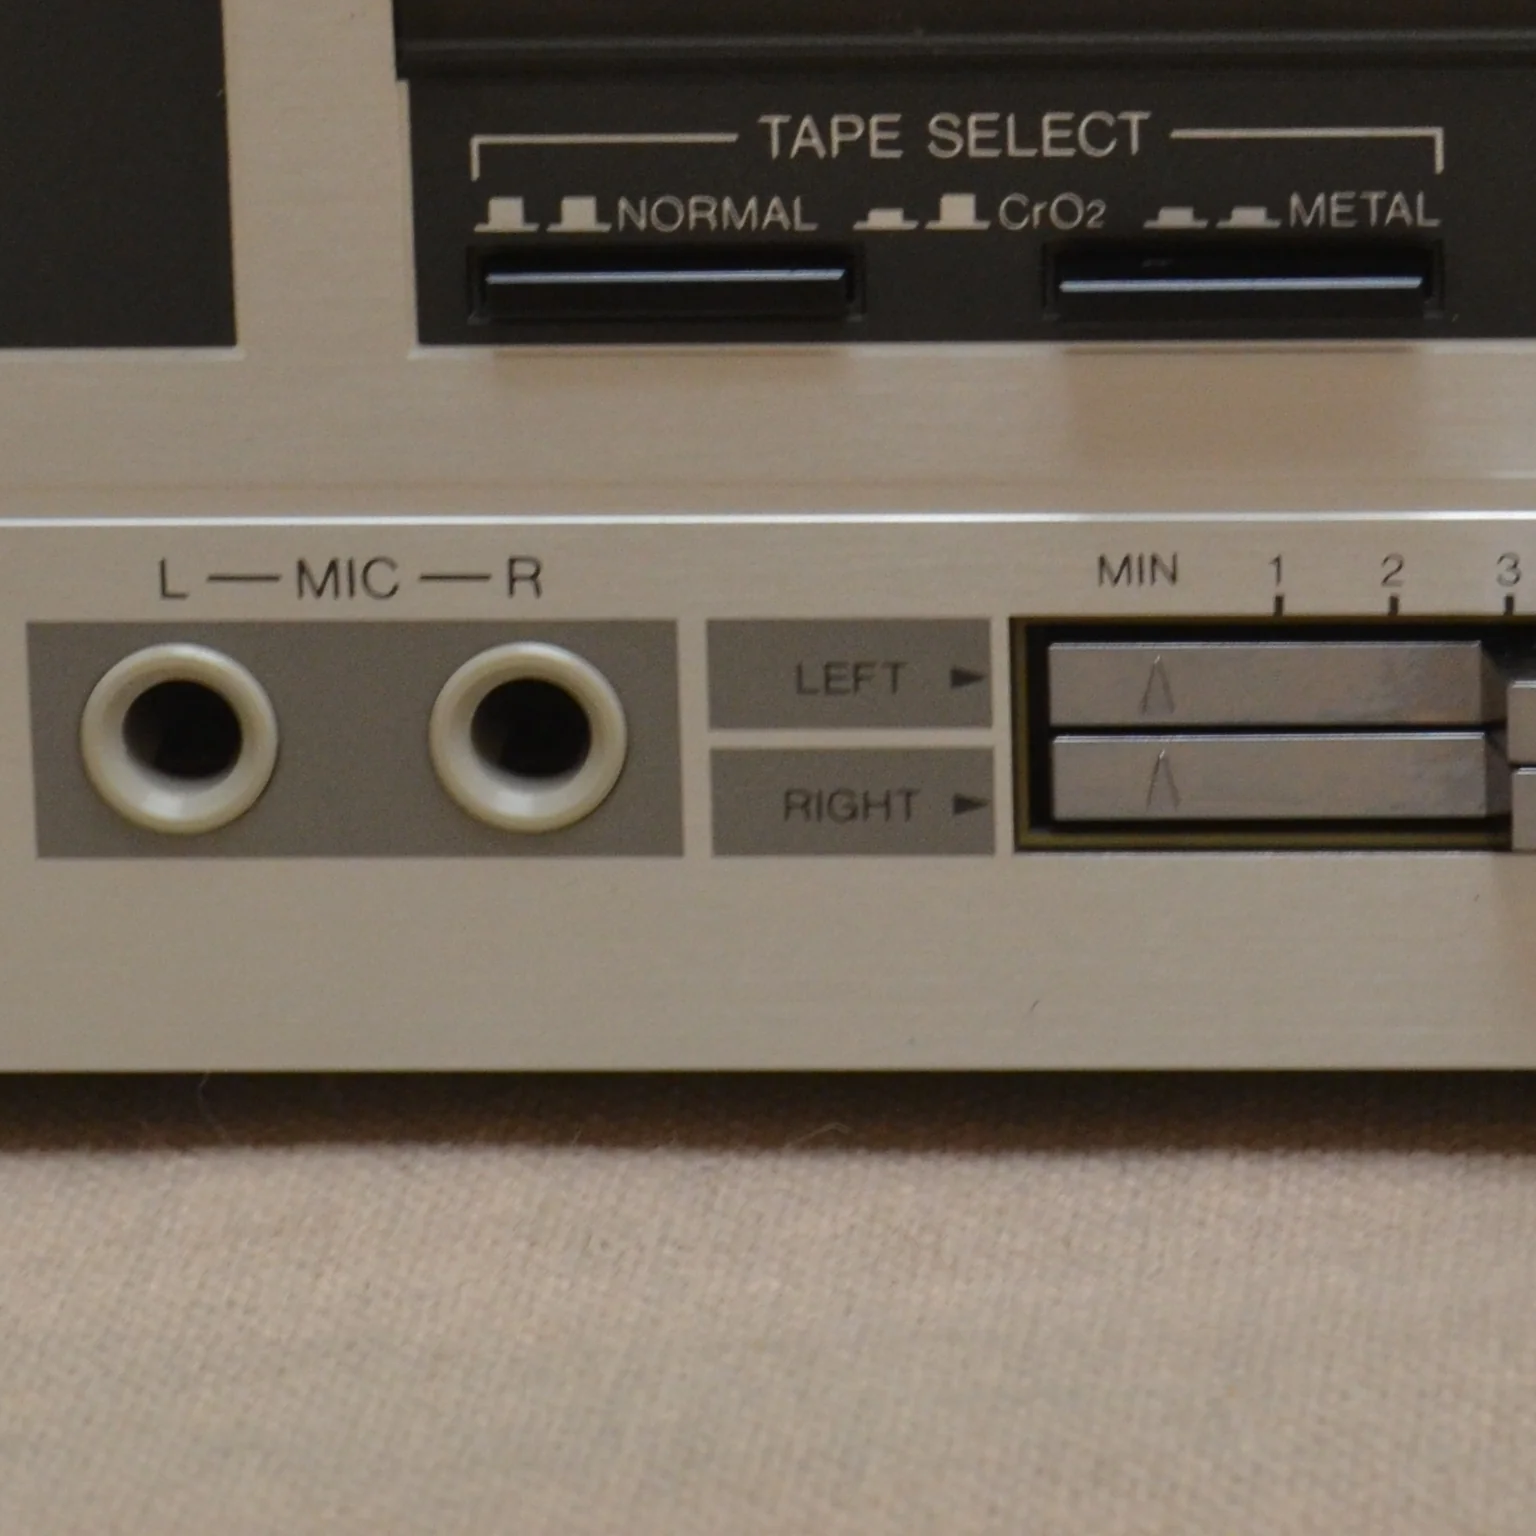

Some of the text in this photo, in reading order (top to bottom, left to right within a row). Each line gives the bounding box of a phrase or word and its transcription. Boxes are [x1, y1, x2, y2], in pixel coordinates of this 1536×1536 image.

[759, 111, 1151, 159] TAPE SELECT
[618, 195, 818, 232] NORMAL
[998, 193, 1107, 230] CrO2
[1289, 191, 1442, 228] METAL
[159, 556, 545, 600] L MIC R
[1097, 552, 1179, 586] MIN
[1269, 553, 1284, 585] 1
[1380, 552, 1405, 585] 2
[1496, 552, 1523, 585] 3
[793, 661, 908, 697] LEFT
[783, 787, 921, 824] RIGHT
